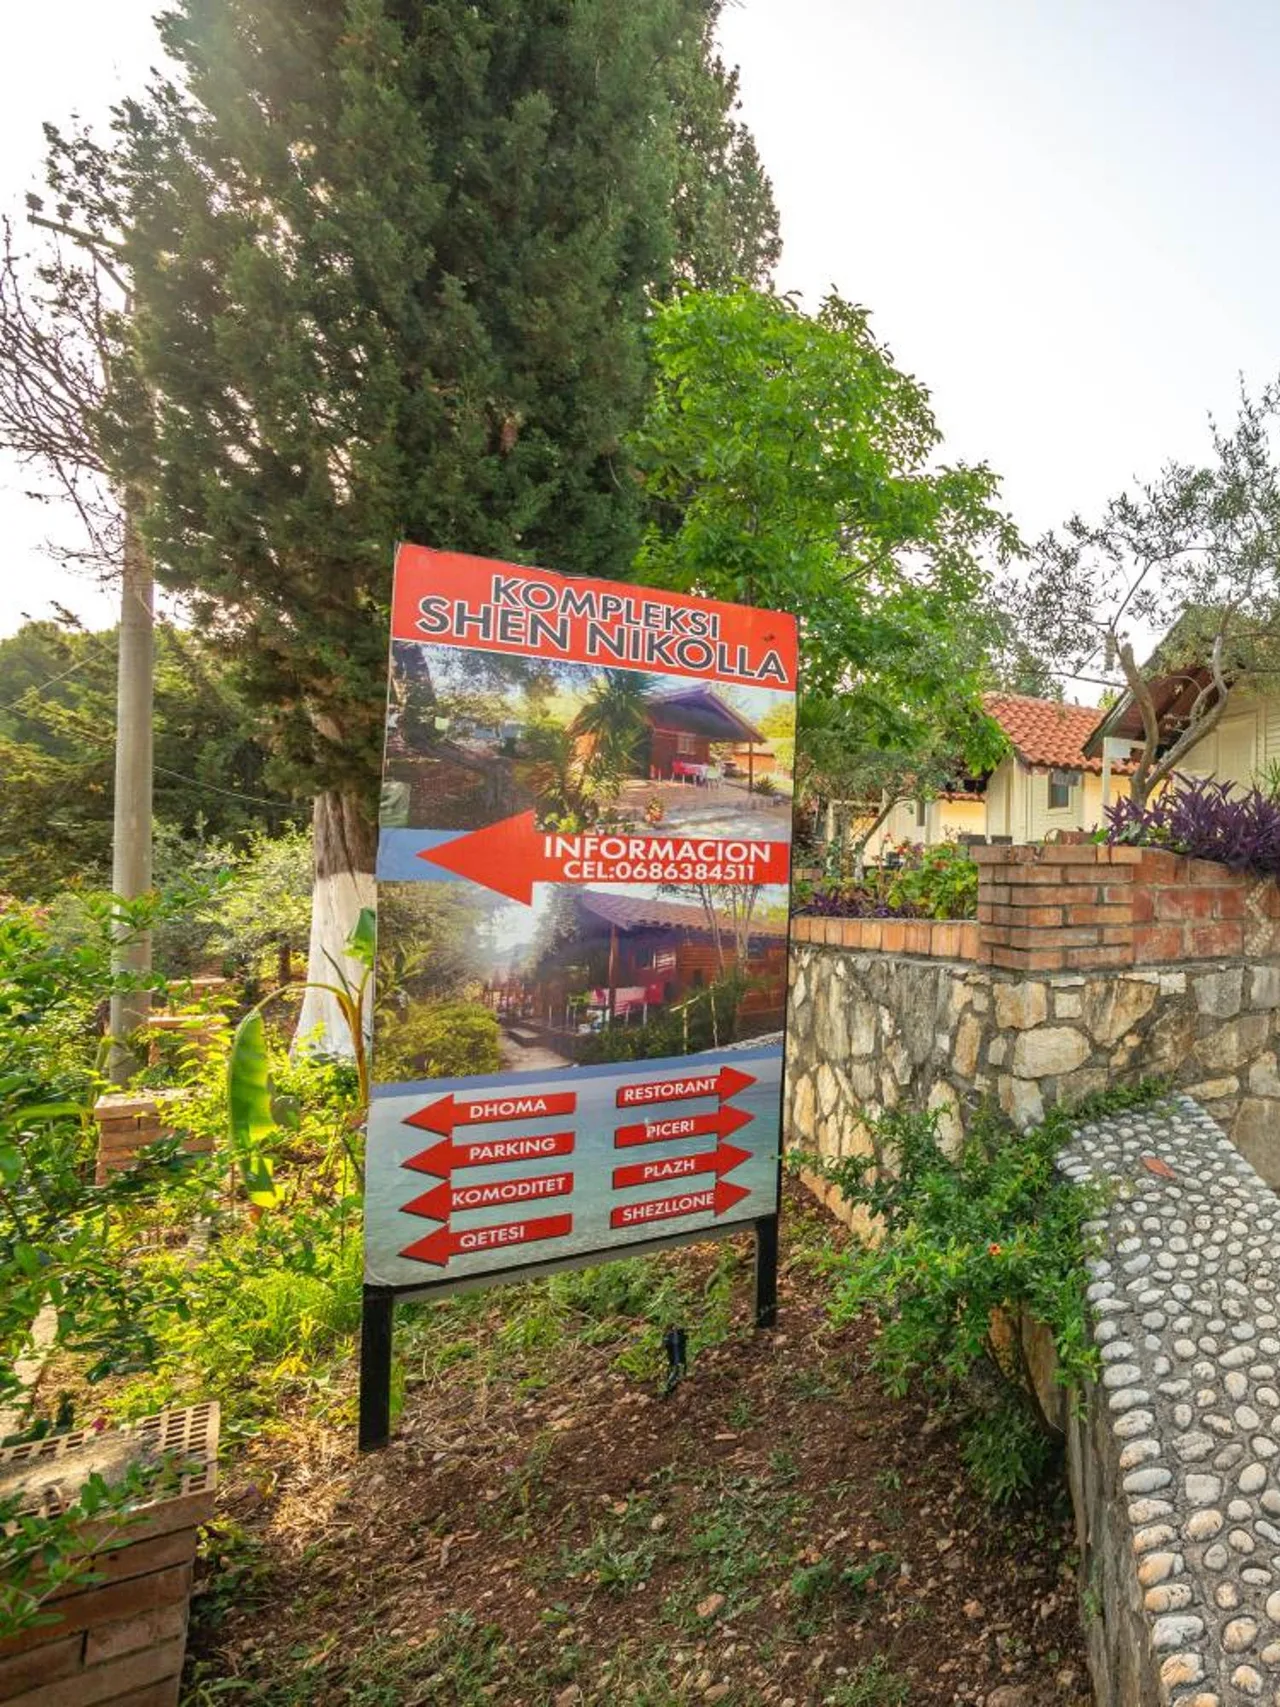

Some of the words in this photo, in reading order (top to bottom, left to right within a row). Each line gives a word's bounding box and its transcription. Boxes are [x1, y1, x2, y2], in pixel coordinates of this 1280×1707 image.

[491, 575, 720, 640] KOMPLEKSI
[416, 595, 570, 651] SHEN
[586, 620, 789, 684] NIKOLLA
[544, 836, 772, 863] INFORMACION
[563, 860, 755, 881] CEL:0686384511
[623, 1077, 718, 1103] RESTORANT
[469, 1098, 547, 1119] DHOMA
[645, 1119, 695, 1139] PICERI
[468, 1137, 557, 1161] PARKING
[643, 1159, 696, 1180] PLAZH
[451, 1176, 567, 1207] KOMODITET
[621, 1192, 715, 1222] SHEZLLONE
[459, 1226, 526, 1249] QETESI
